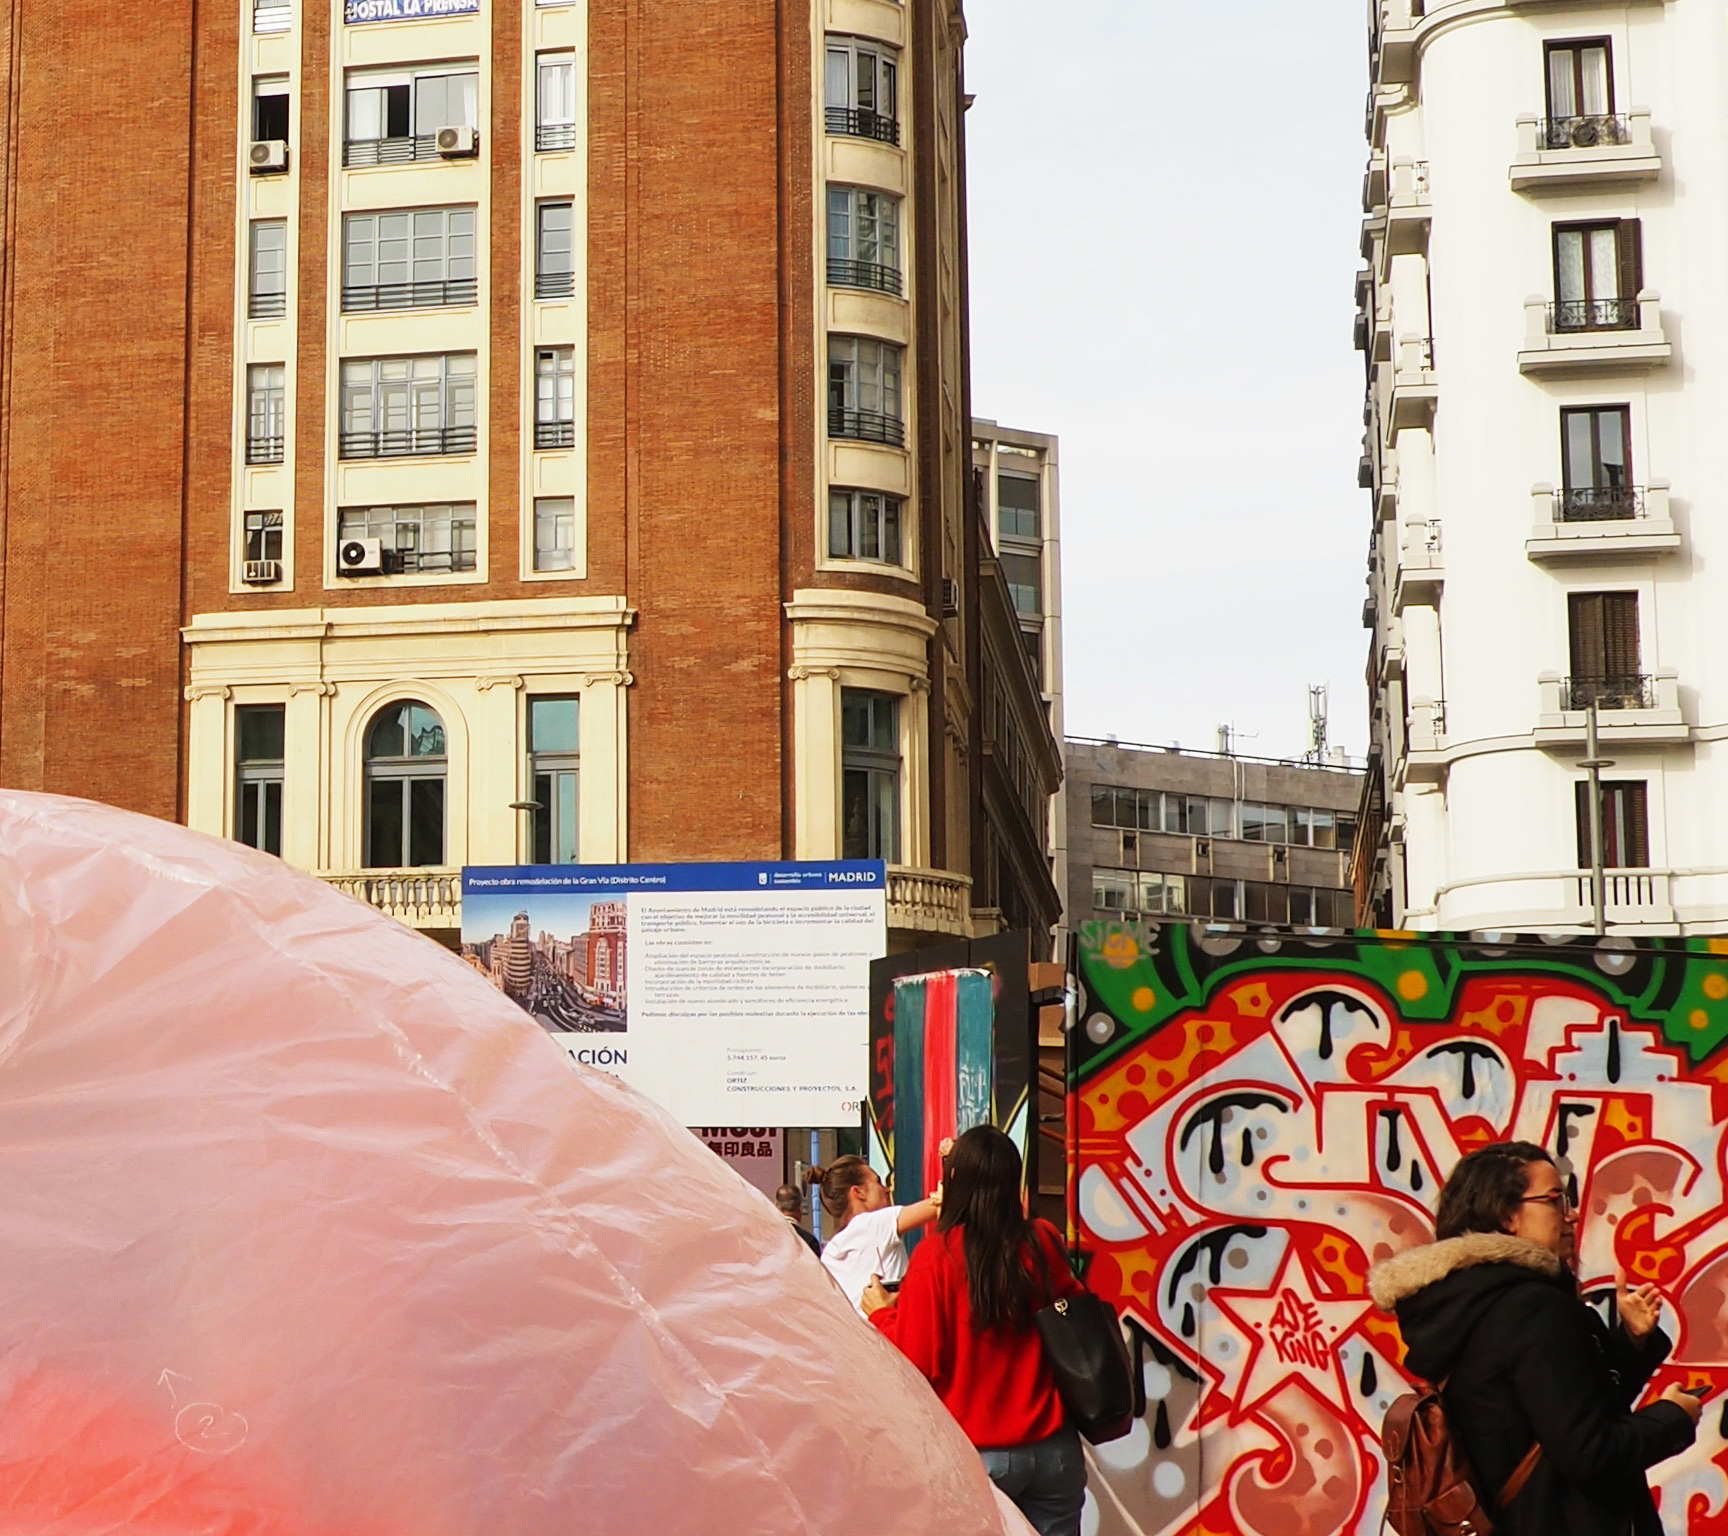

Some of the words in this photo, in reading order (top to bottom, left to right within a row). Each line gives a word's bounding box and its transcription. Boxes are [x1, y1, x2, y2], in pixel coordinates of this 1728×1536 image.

[828, 872, 876, 882] MADRID
[468, 878, 499, 887] Proyecto
[841, 1101, 860, 1112] OR
[1269, 1330, 1330, 1371] KING
